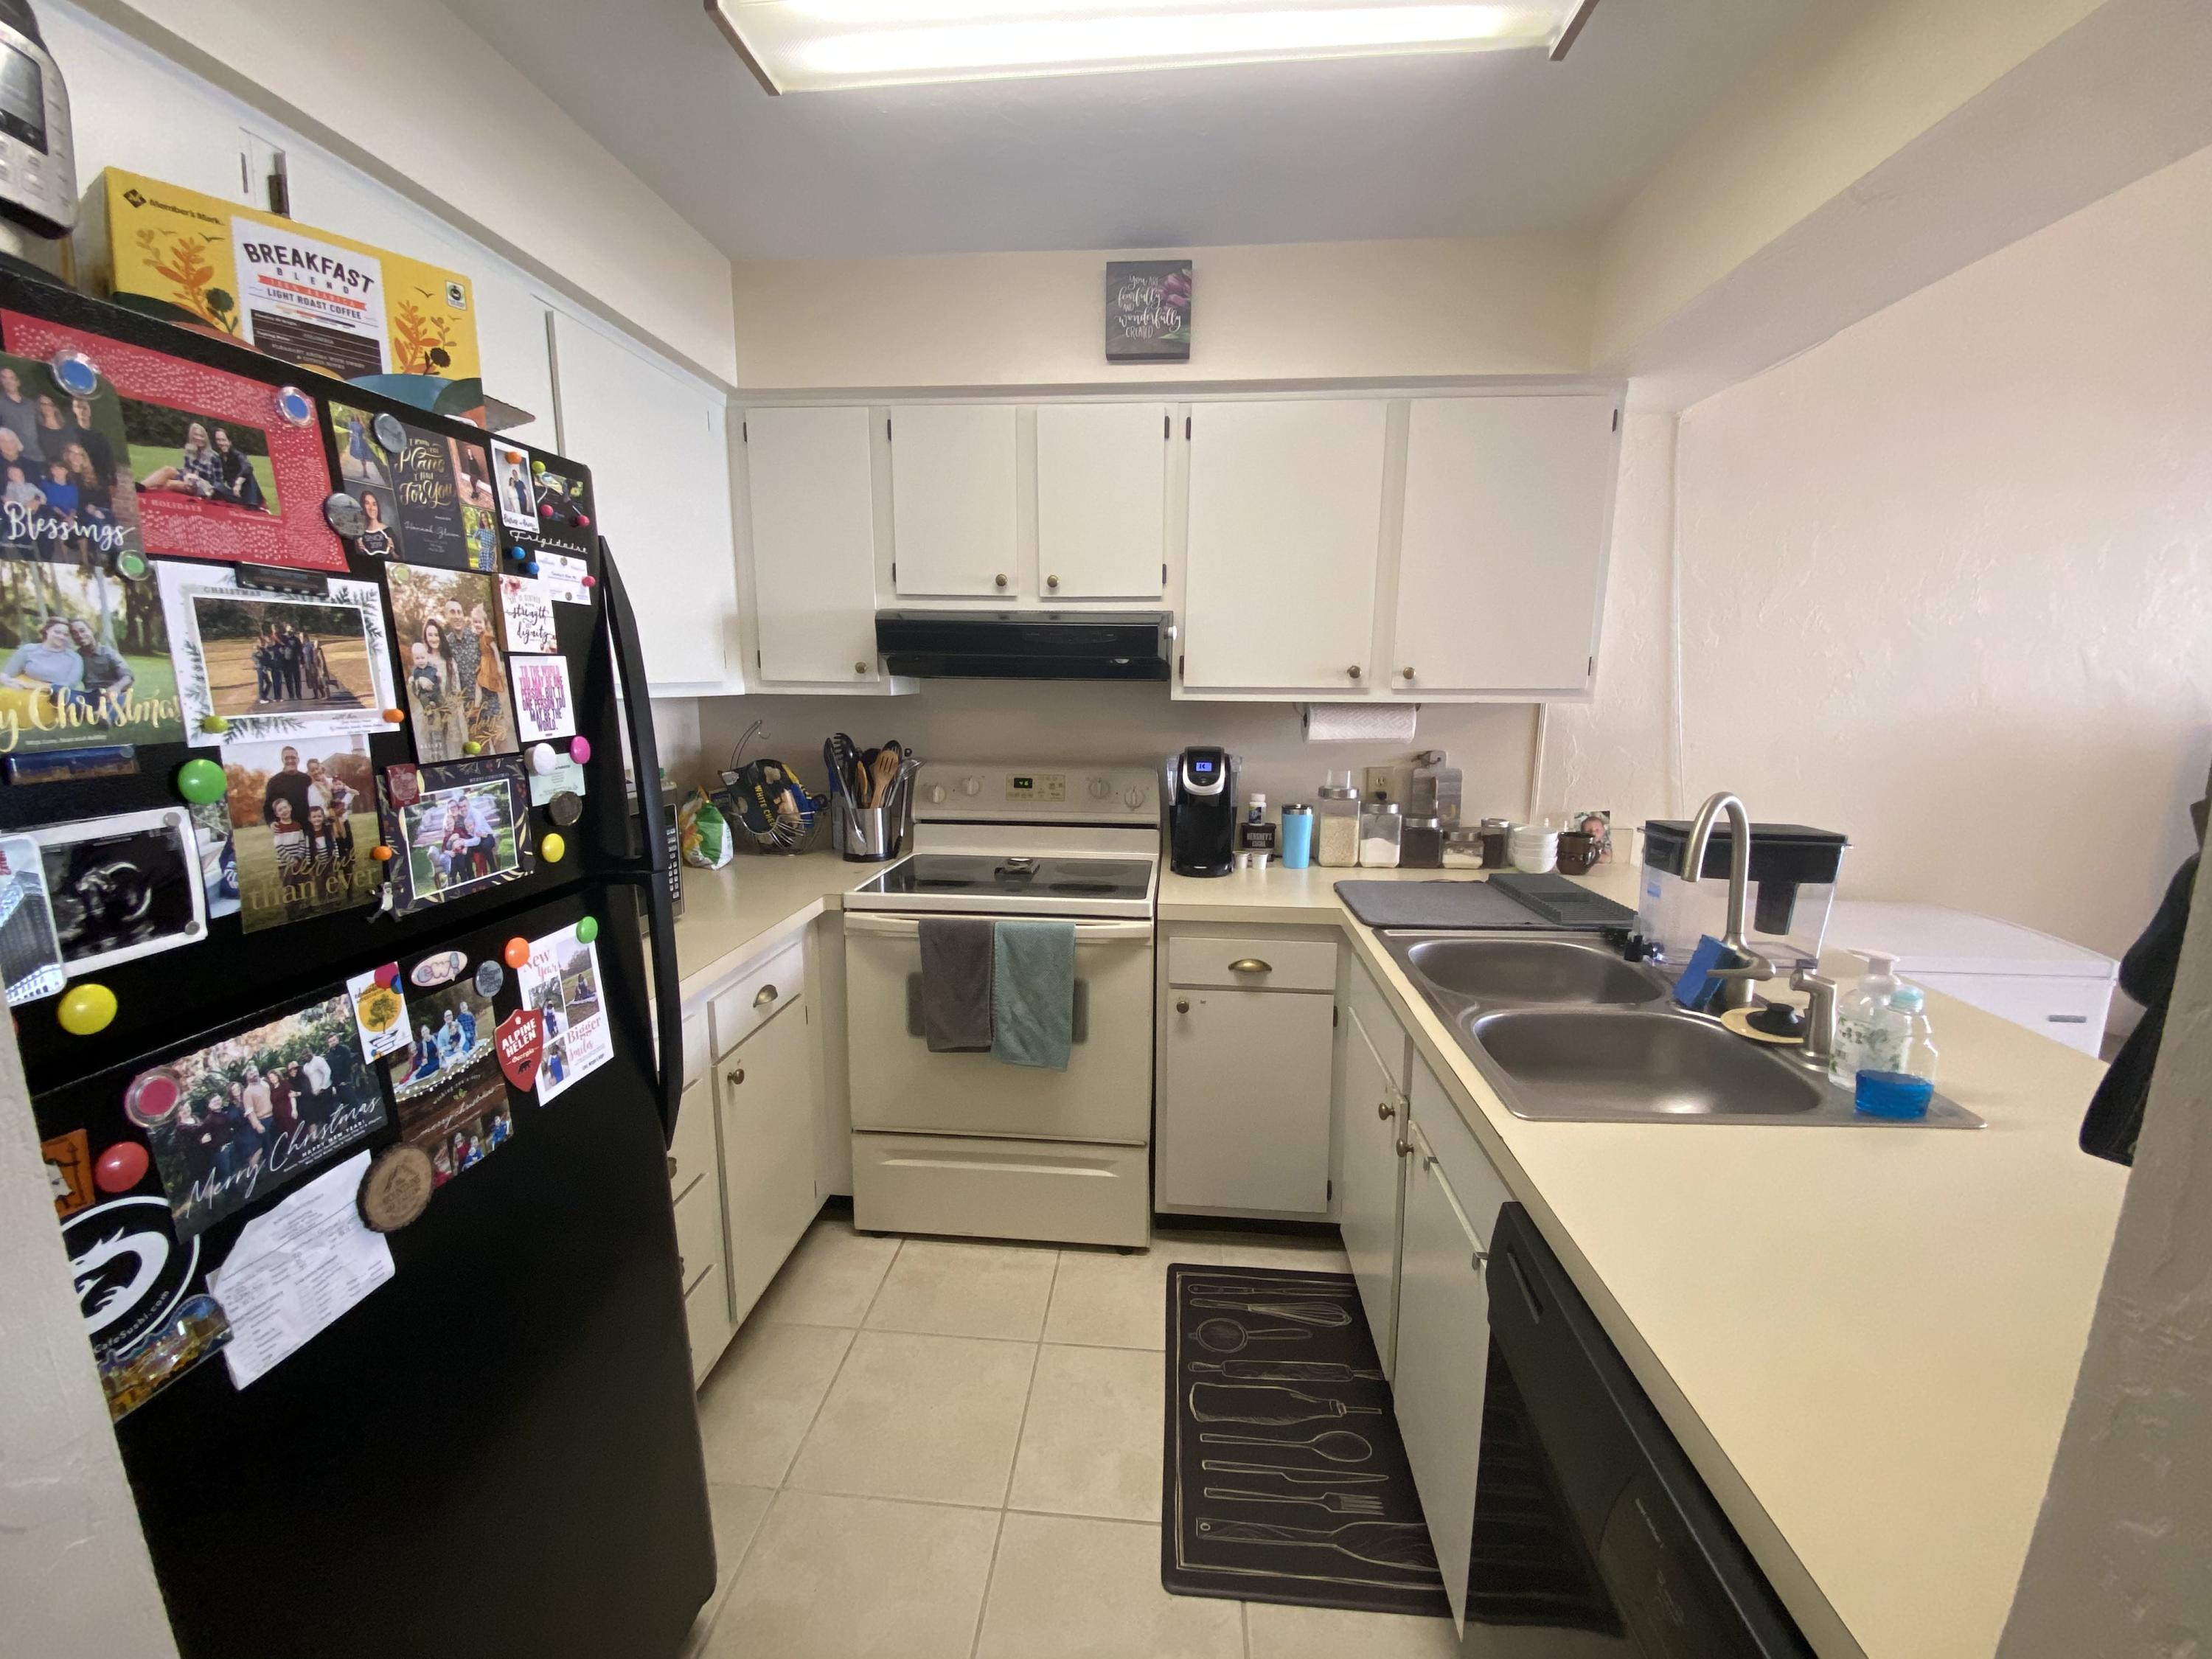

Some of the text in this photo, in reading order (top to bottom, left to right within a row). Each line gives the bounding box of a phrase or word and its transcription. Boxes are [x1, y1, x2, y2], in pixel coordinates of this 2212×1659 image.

[243, 243, 375, 293] BREAKFAST
[276, 267, 349, 294] BLEND
[267, 288, 362, 320] LIGHT ROAST COFFEE
[1114, 307, 1181, 333] wonderfully
[150, 498, 203, 512] HOLIDAYS
[3, 500, 136, 552] Blessings
[509, 530, 588, 554] Frigidaire
[204, 585, 262, 597] CHRISTMAS
[754, 784, 768, 809] WHITE
[247, 866, 378, 911] than ever
[501, 1018, 537, 1051] ALPINE
[505, 1029, 537, 1058] HELEN
[567, 1015, 602, 1045] Bigger
[302, 1141, 324, 1158] HAPPY
[328, 1132, 343, 1144] NEW
[345, 1119, 365, 1133] YEAR!
[186, 1158, 266, 1220] Merry
[268, 1096, 382, 1172] Christmas
